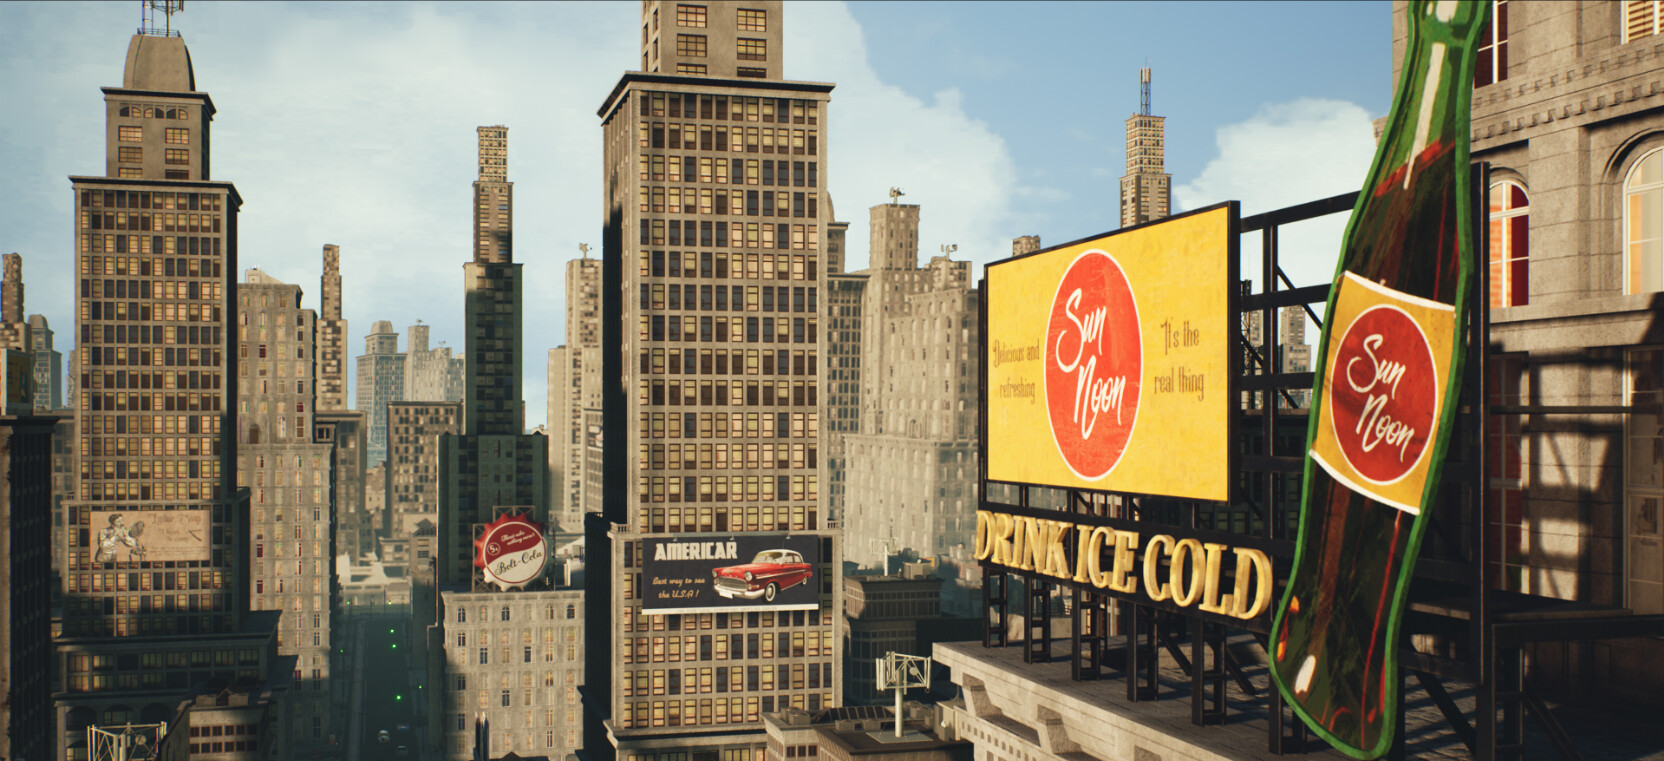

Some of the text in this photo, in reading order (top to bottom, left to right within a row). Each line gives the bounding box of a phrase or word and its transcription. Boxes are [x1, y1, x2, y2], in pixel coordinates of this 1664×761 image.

[1056, 288, 1107, 373] Sun
[1183, 321, 1200, 347] the
[993, 338, 1040, 368] Delicious and
[1346, 334, 1406, 400] Sun
[1000, 378, 1036, 405] refreshing
[1074, 354, 1126, 440] Noon
[1154, 367, 1204, 402] real thing
[1356, 394, 1415, 463] Noon
[494, 550, 542, 576] Bolt-Cola
[654, 542, 738, 561] AMERICAR
[973, 510, 1273, 620] DRINK ICE COLD
[652, 576, 668, 585] Best
[668, 578, 684, 588] way
[658, 589, 670, 598] the
